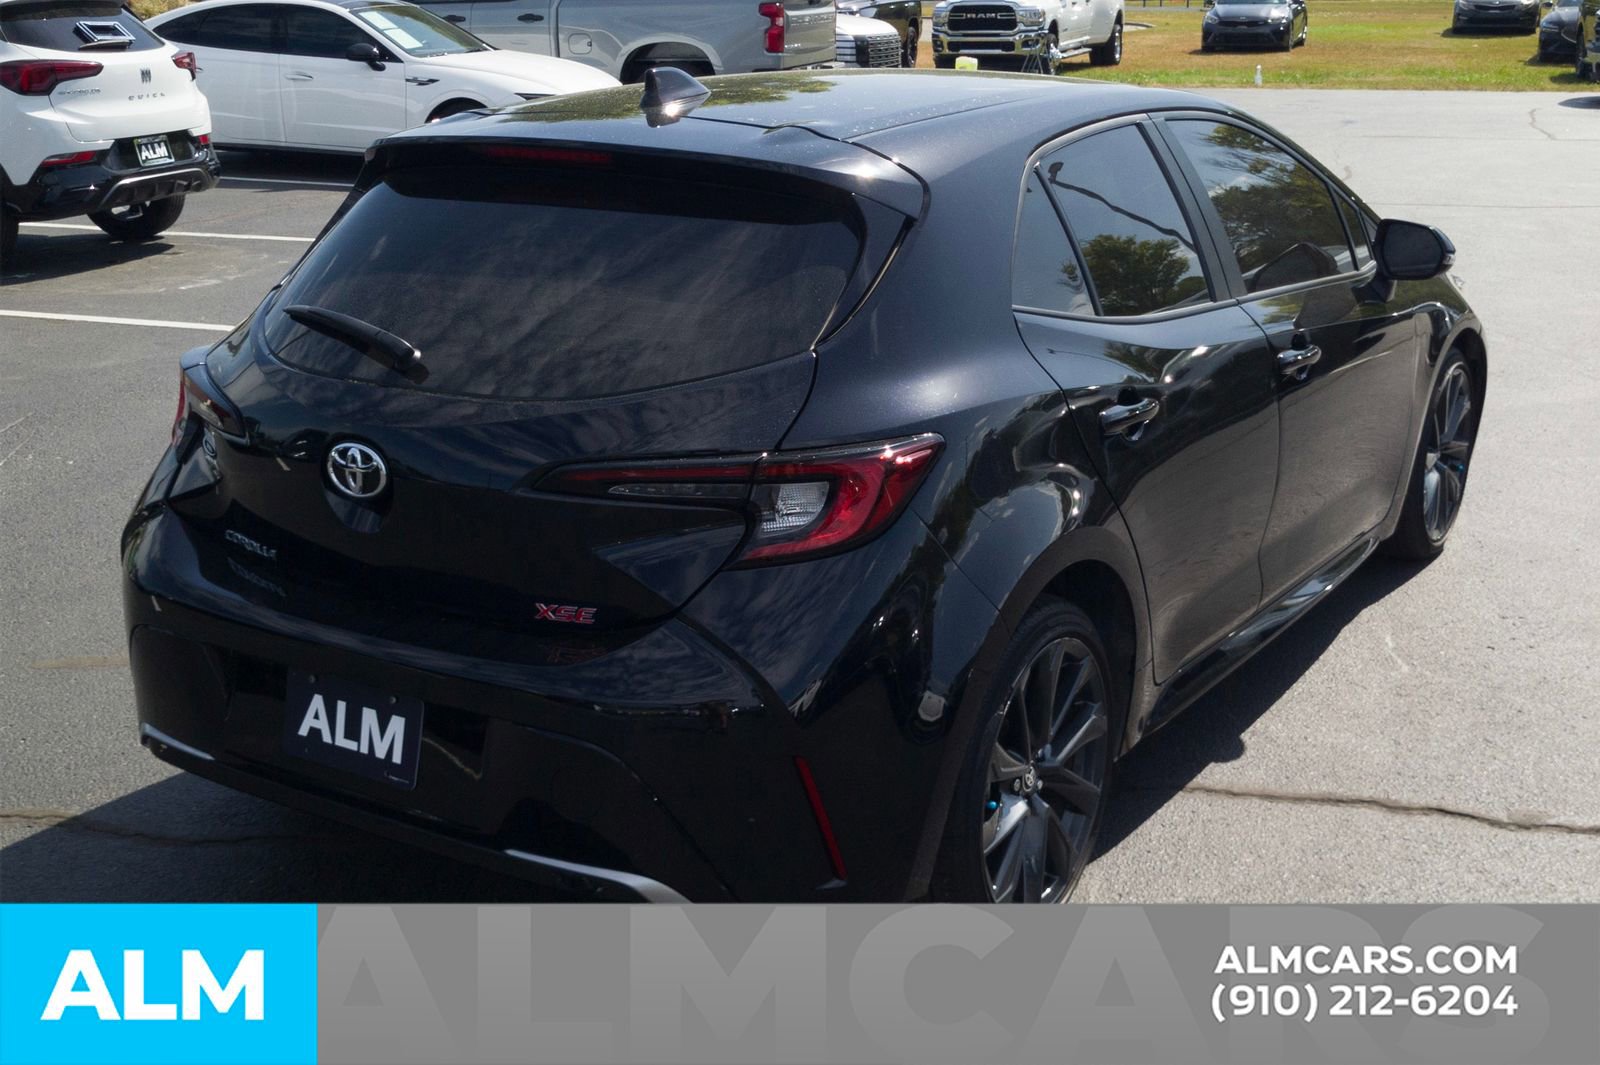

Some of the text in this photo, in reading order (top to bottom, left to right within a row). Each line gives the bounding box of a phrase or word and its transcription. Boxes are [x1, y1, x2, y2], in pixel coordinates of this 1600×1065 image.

[141, 142, 169, 160] ALM
[534, 603, 597, 624] XSE
[297, 693, 406, 765] ALM
